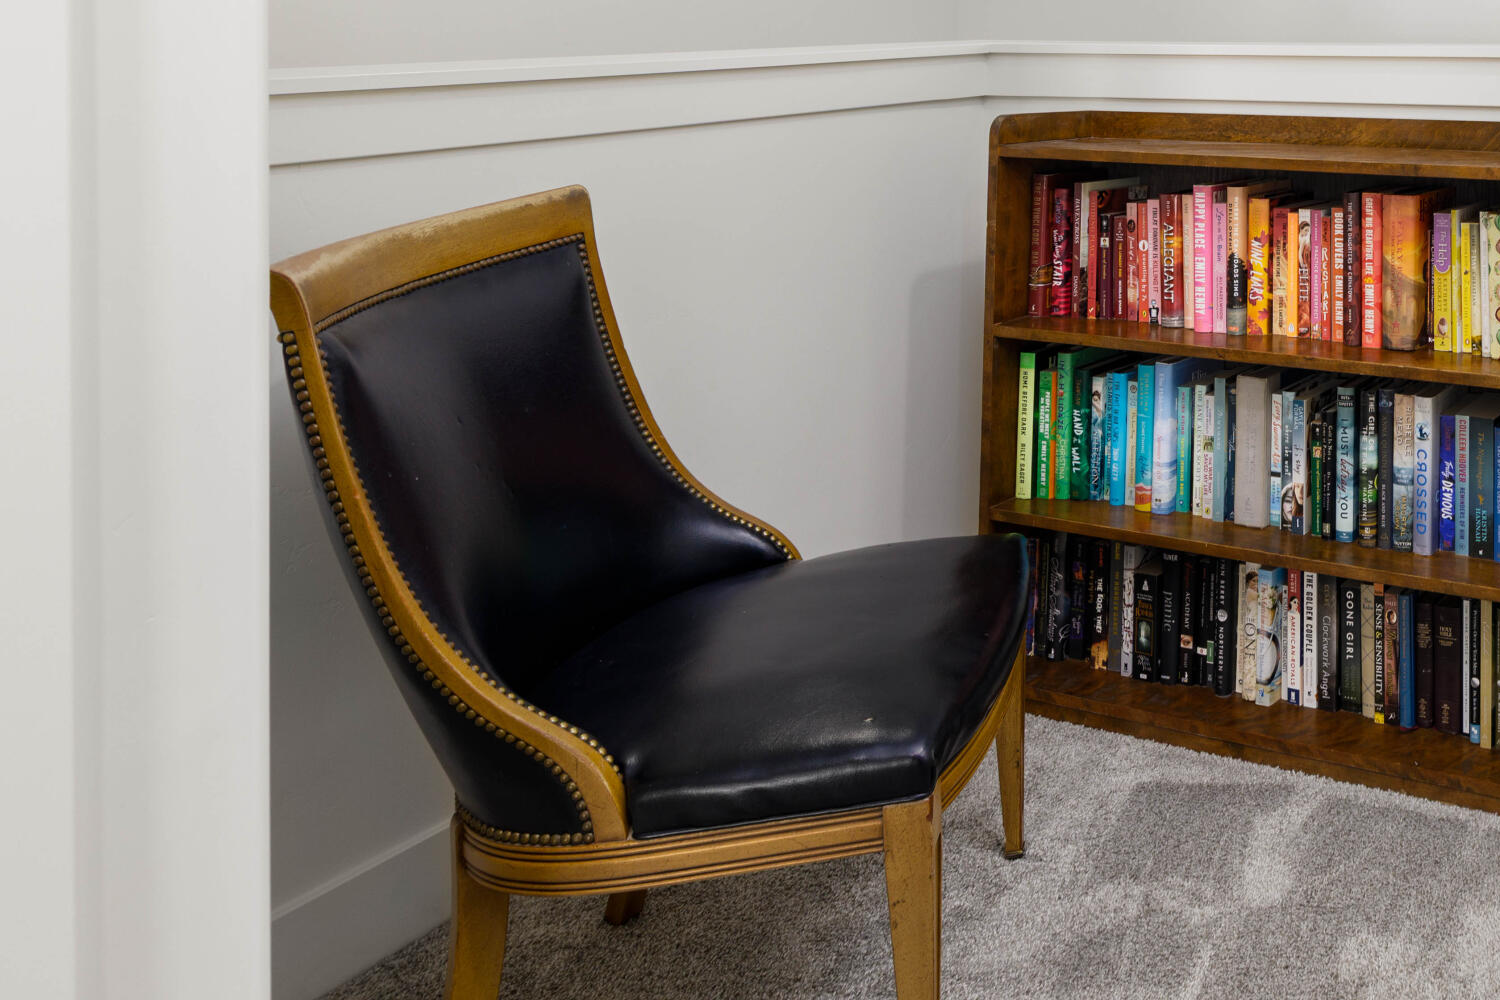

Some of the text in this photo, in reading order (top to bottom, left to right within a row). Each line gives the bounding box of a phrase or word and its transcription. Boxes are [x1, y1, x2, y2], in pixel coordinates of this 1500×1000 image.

[1194, 192, 1205, 248] HAPPY PLACE
[1335, 212, 1343, 269] BOOK LOVERS
[1052, 259, 1063, 287] STAIR
[1163, 222, 1174, 303] ALLEGIANT
[1249, 240, 1263, 302] NINE LIARS
[1365, 262, 1373, 275] LIFE
[1437, 243, 1448, 266] Help
[1195, 257, 1205, 314] EMILY HENRY
[1335, 275, 1343, 326] EMILY HENRY
[1364, 284, 1374, 334] EMILY HENRY
[1073, 409, 1083, 435] HAND
[1341, 426, 1349, 457] MUST
[1071, 447, 1080, 473] WALL
[1441, 480, 1453, 520] DEVIOUS
[1162, 591, 1175, 632] panic
[1320, 615, 1331, 699] Clockwork Angel
[1346, 632, 1354, 660] GIRL
[1375, 640, 1383, 695] SENSIBILITY
